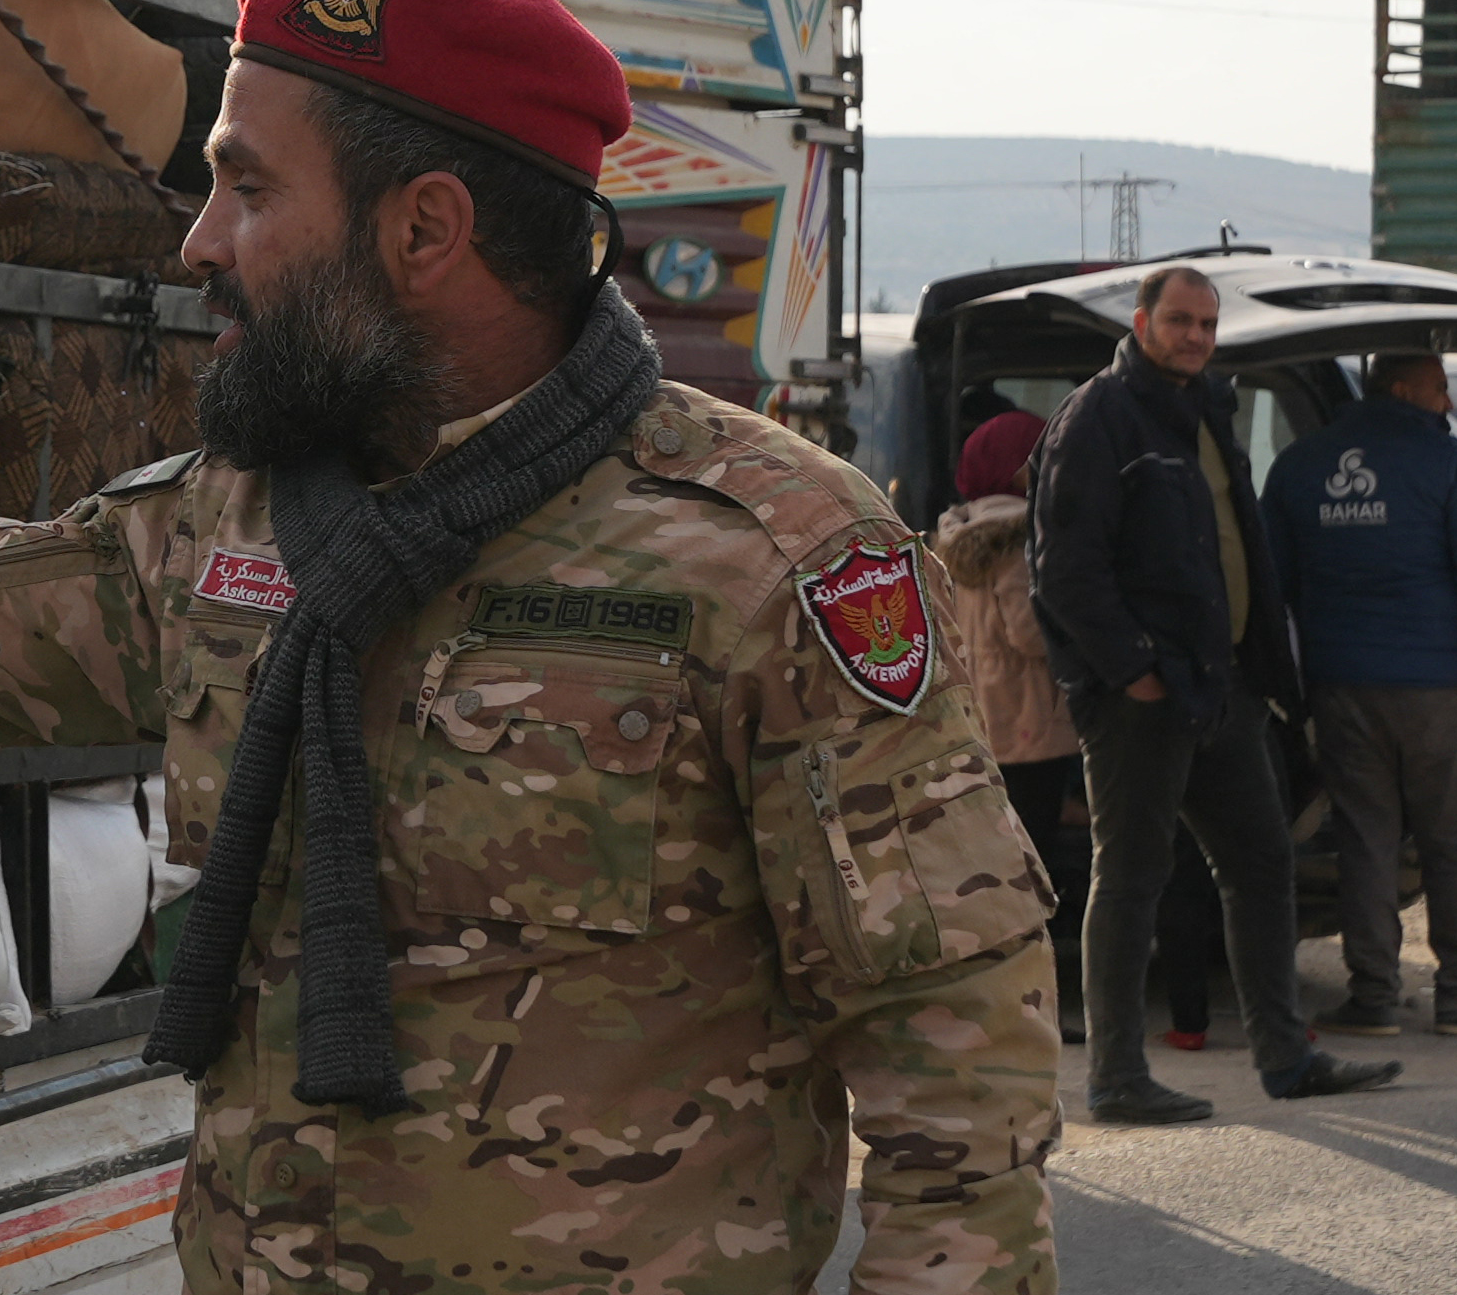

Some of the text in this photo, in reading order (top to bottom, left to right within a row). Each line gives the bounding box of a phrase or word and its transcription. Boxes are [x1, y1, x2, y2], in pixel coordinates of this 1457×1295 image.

[1319, 501, 1387, 520] BAHAR
[216, 557, 283, 585] العسكرية
[597, 598, 680, 634] 1988
